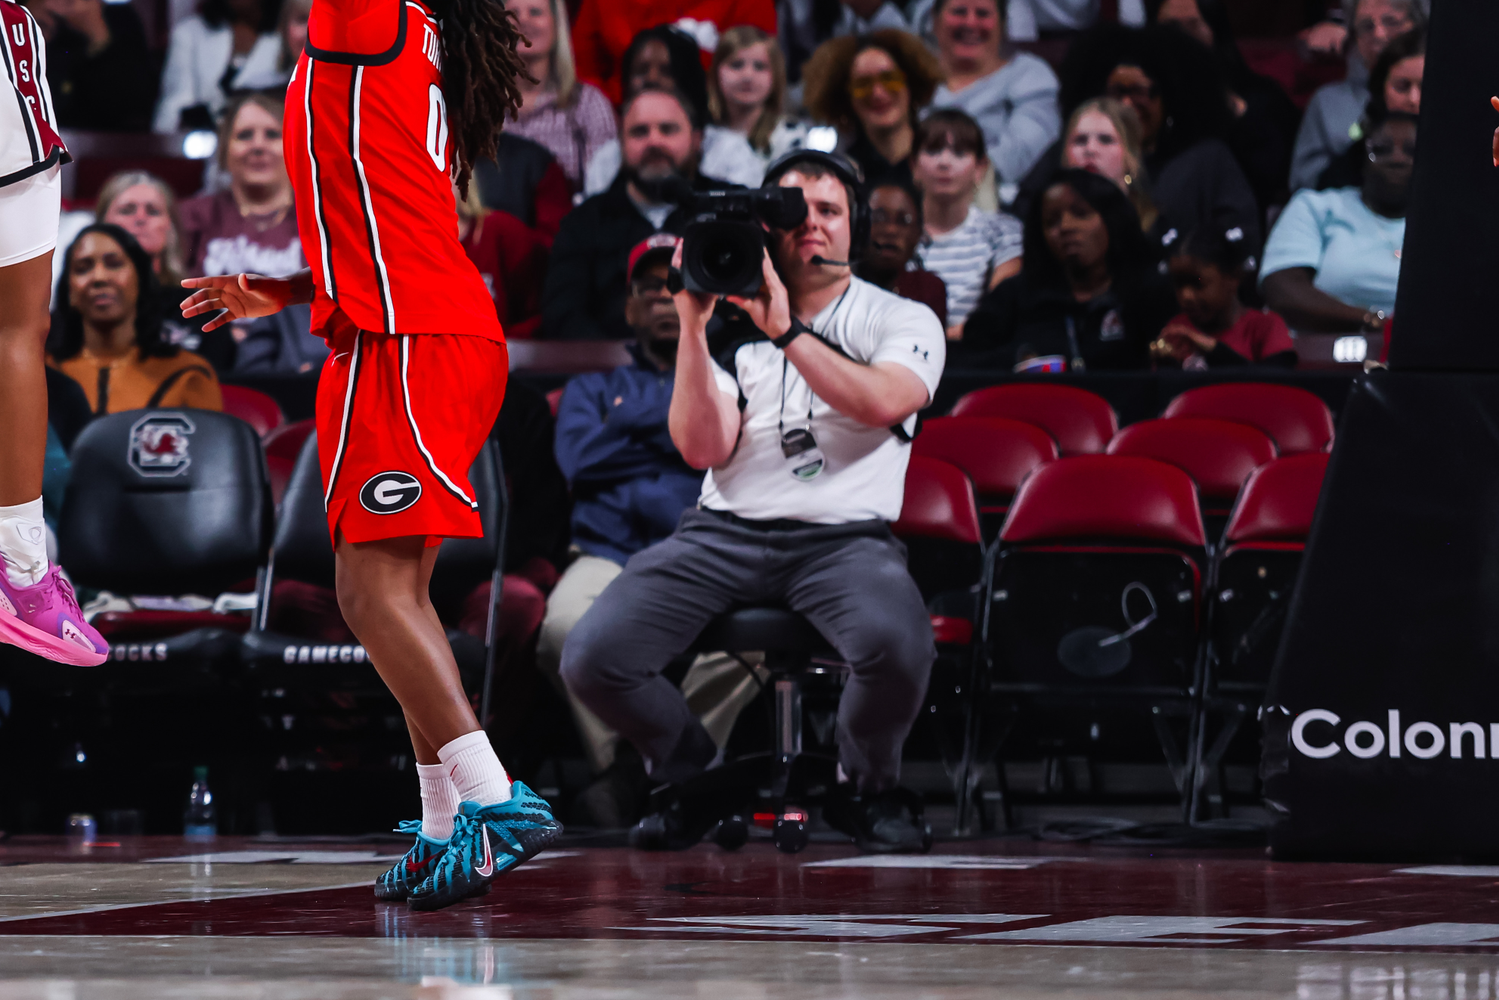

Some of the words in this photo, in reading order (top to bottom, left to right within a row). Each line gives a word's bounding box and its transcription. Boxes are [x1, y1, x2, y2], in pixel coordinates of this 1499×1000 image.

[426, 83, 449, 173] 0
[284, 645, 370, 664] GAMECO
[1291, 708, 1499, 760] Colon
